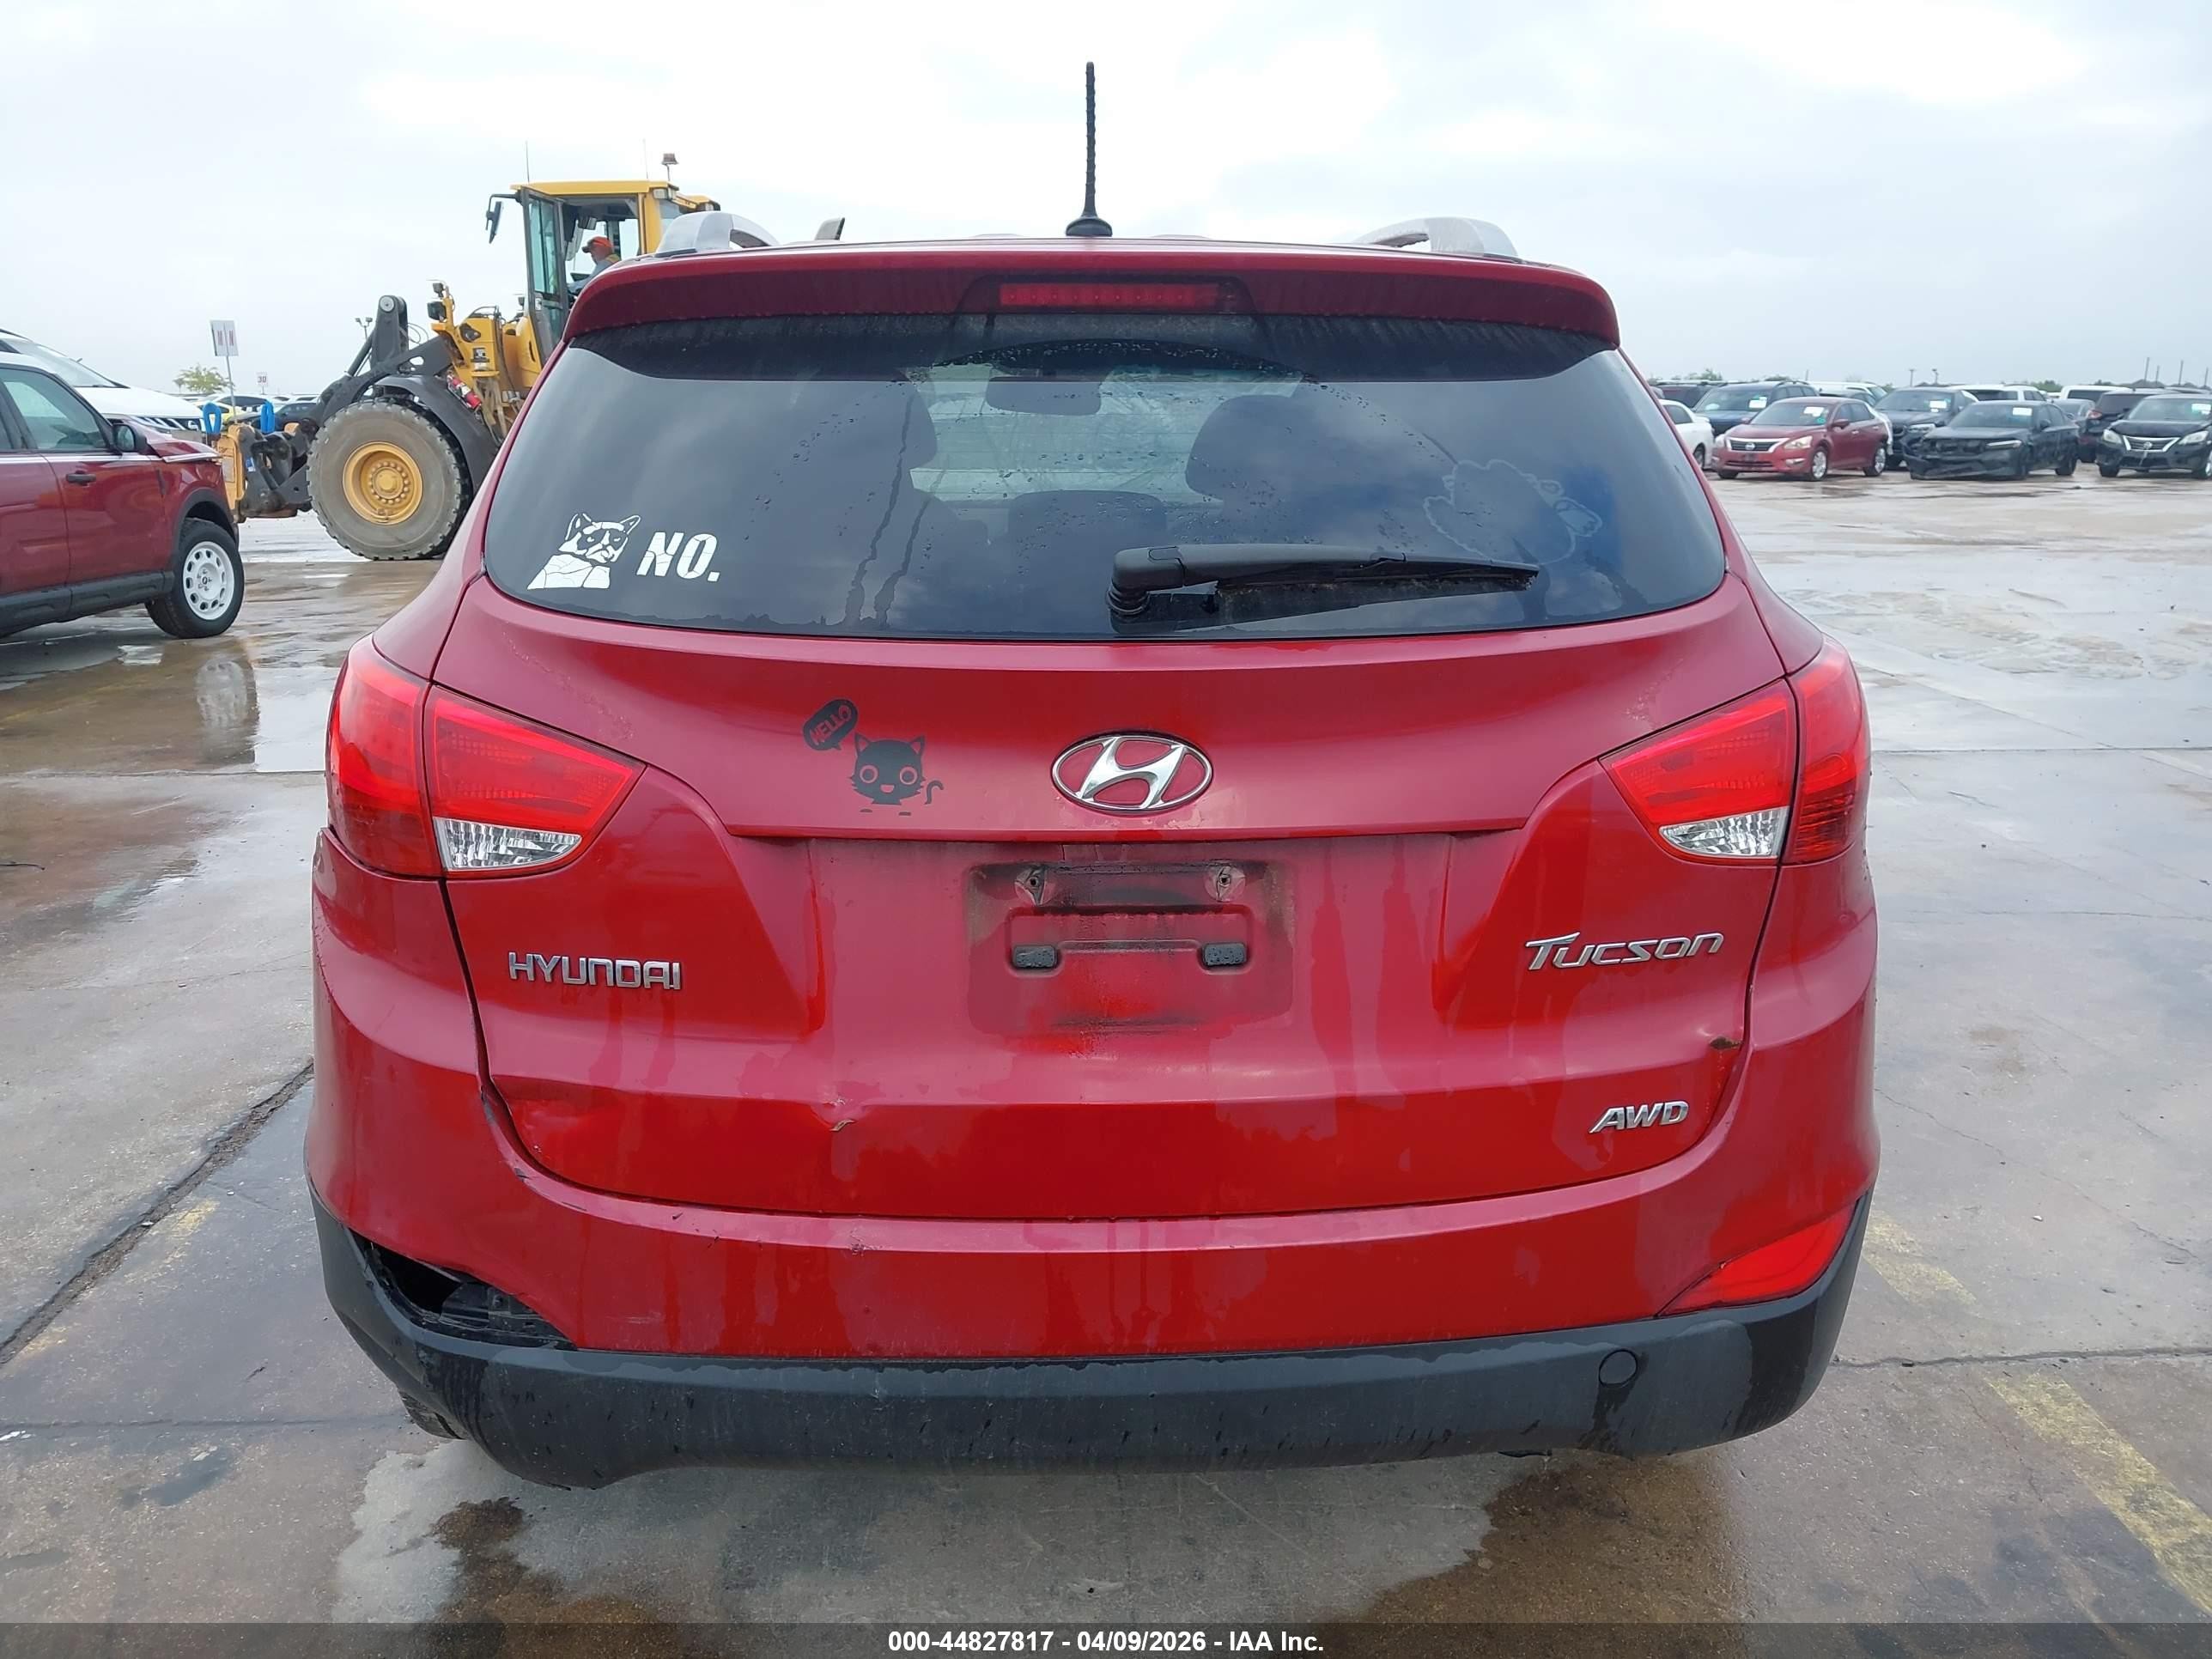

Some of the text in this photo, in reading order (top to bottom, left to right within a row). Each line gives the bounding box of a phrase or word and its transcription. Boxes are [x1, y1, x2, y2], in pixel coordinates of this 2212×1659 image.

[636, 532, 720, 582] NO.
[809, 704, 852, 746] HELLO
[508, 951, 681, 990] HYUNDAI
[1589, 1100, 1689, 1133] AWD
